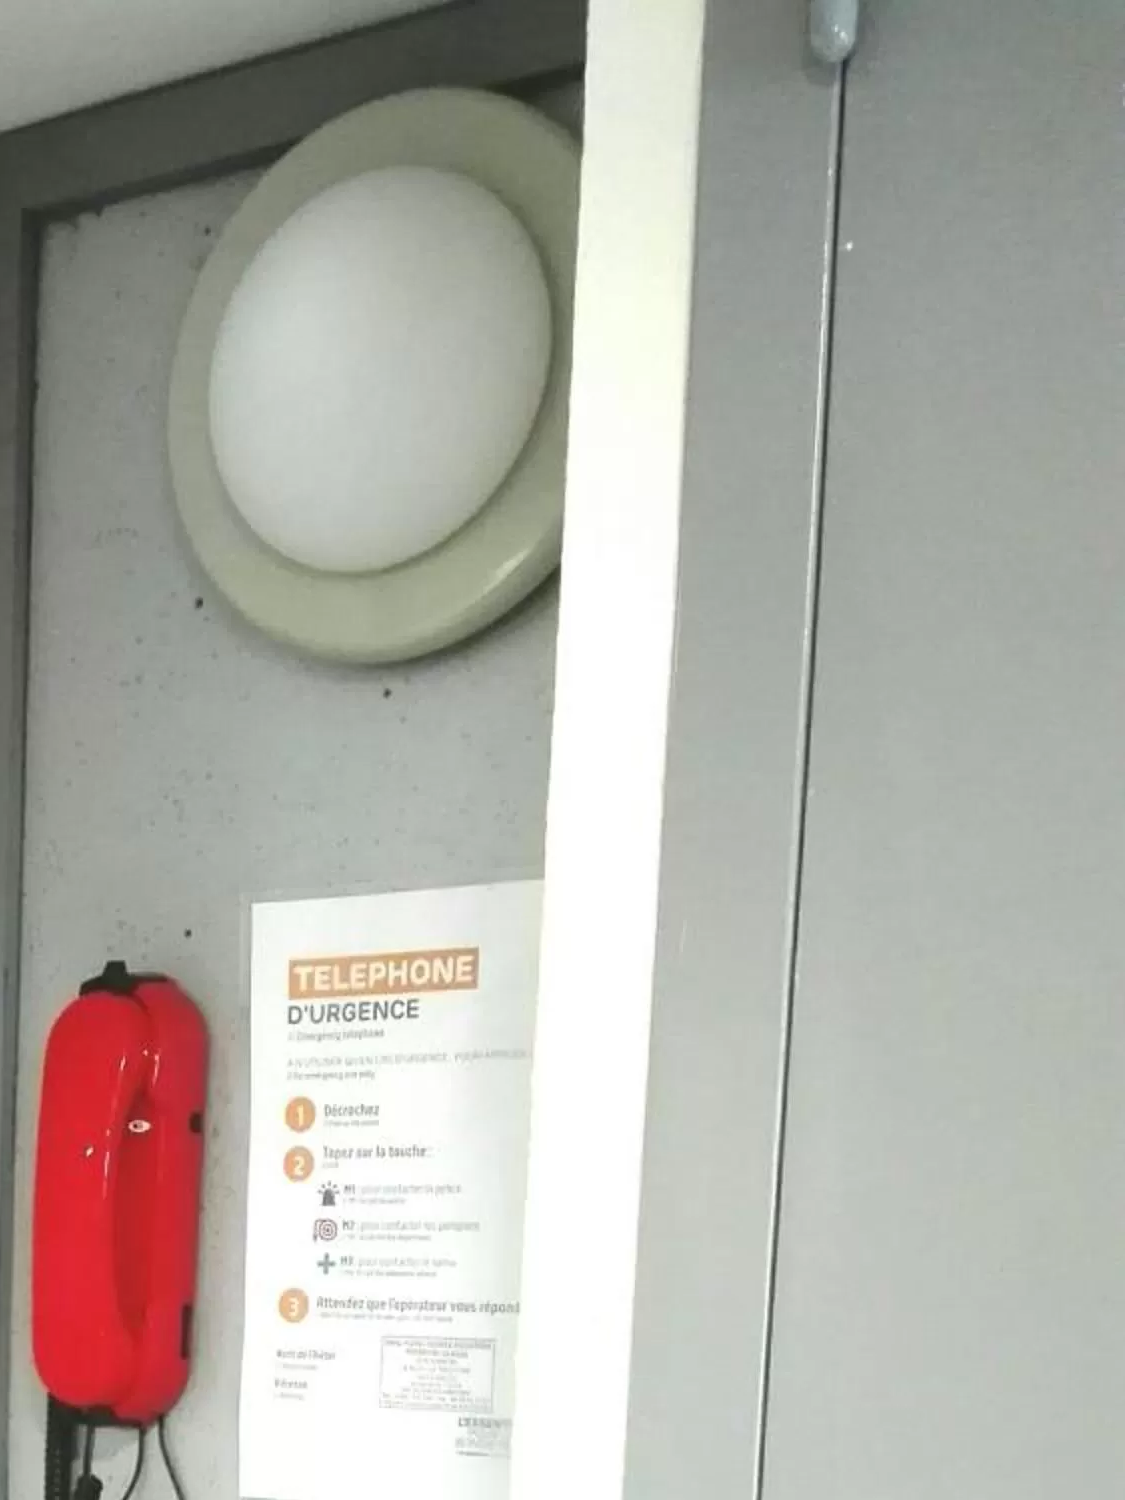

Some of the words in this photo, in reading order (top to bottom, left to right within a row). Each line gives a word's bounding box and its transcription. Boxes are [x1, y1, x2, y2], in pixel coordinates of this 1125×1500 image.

[293, 955, 474, 992] TELEPHONE
[287, 998, 421, 1025] D'URGENCE
[293, 1156, 306, 1176] 2
